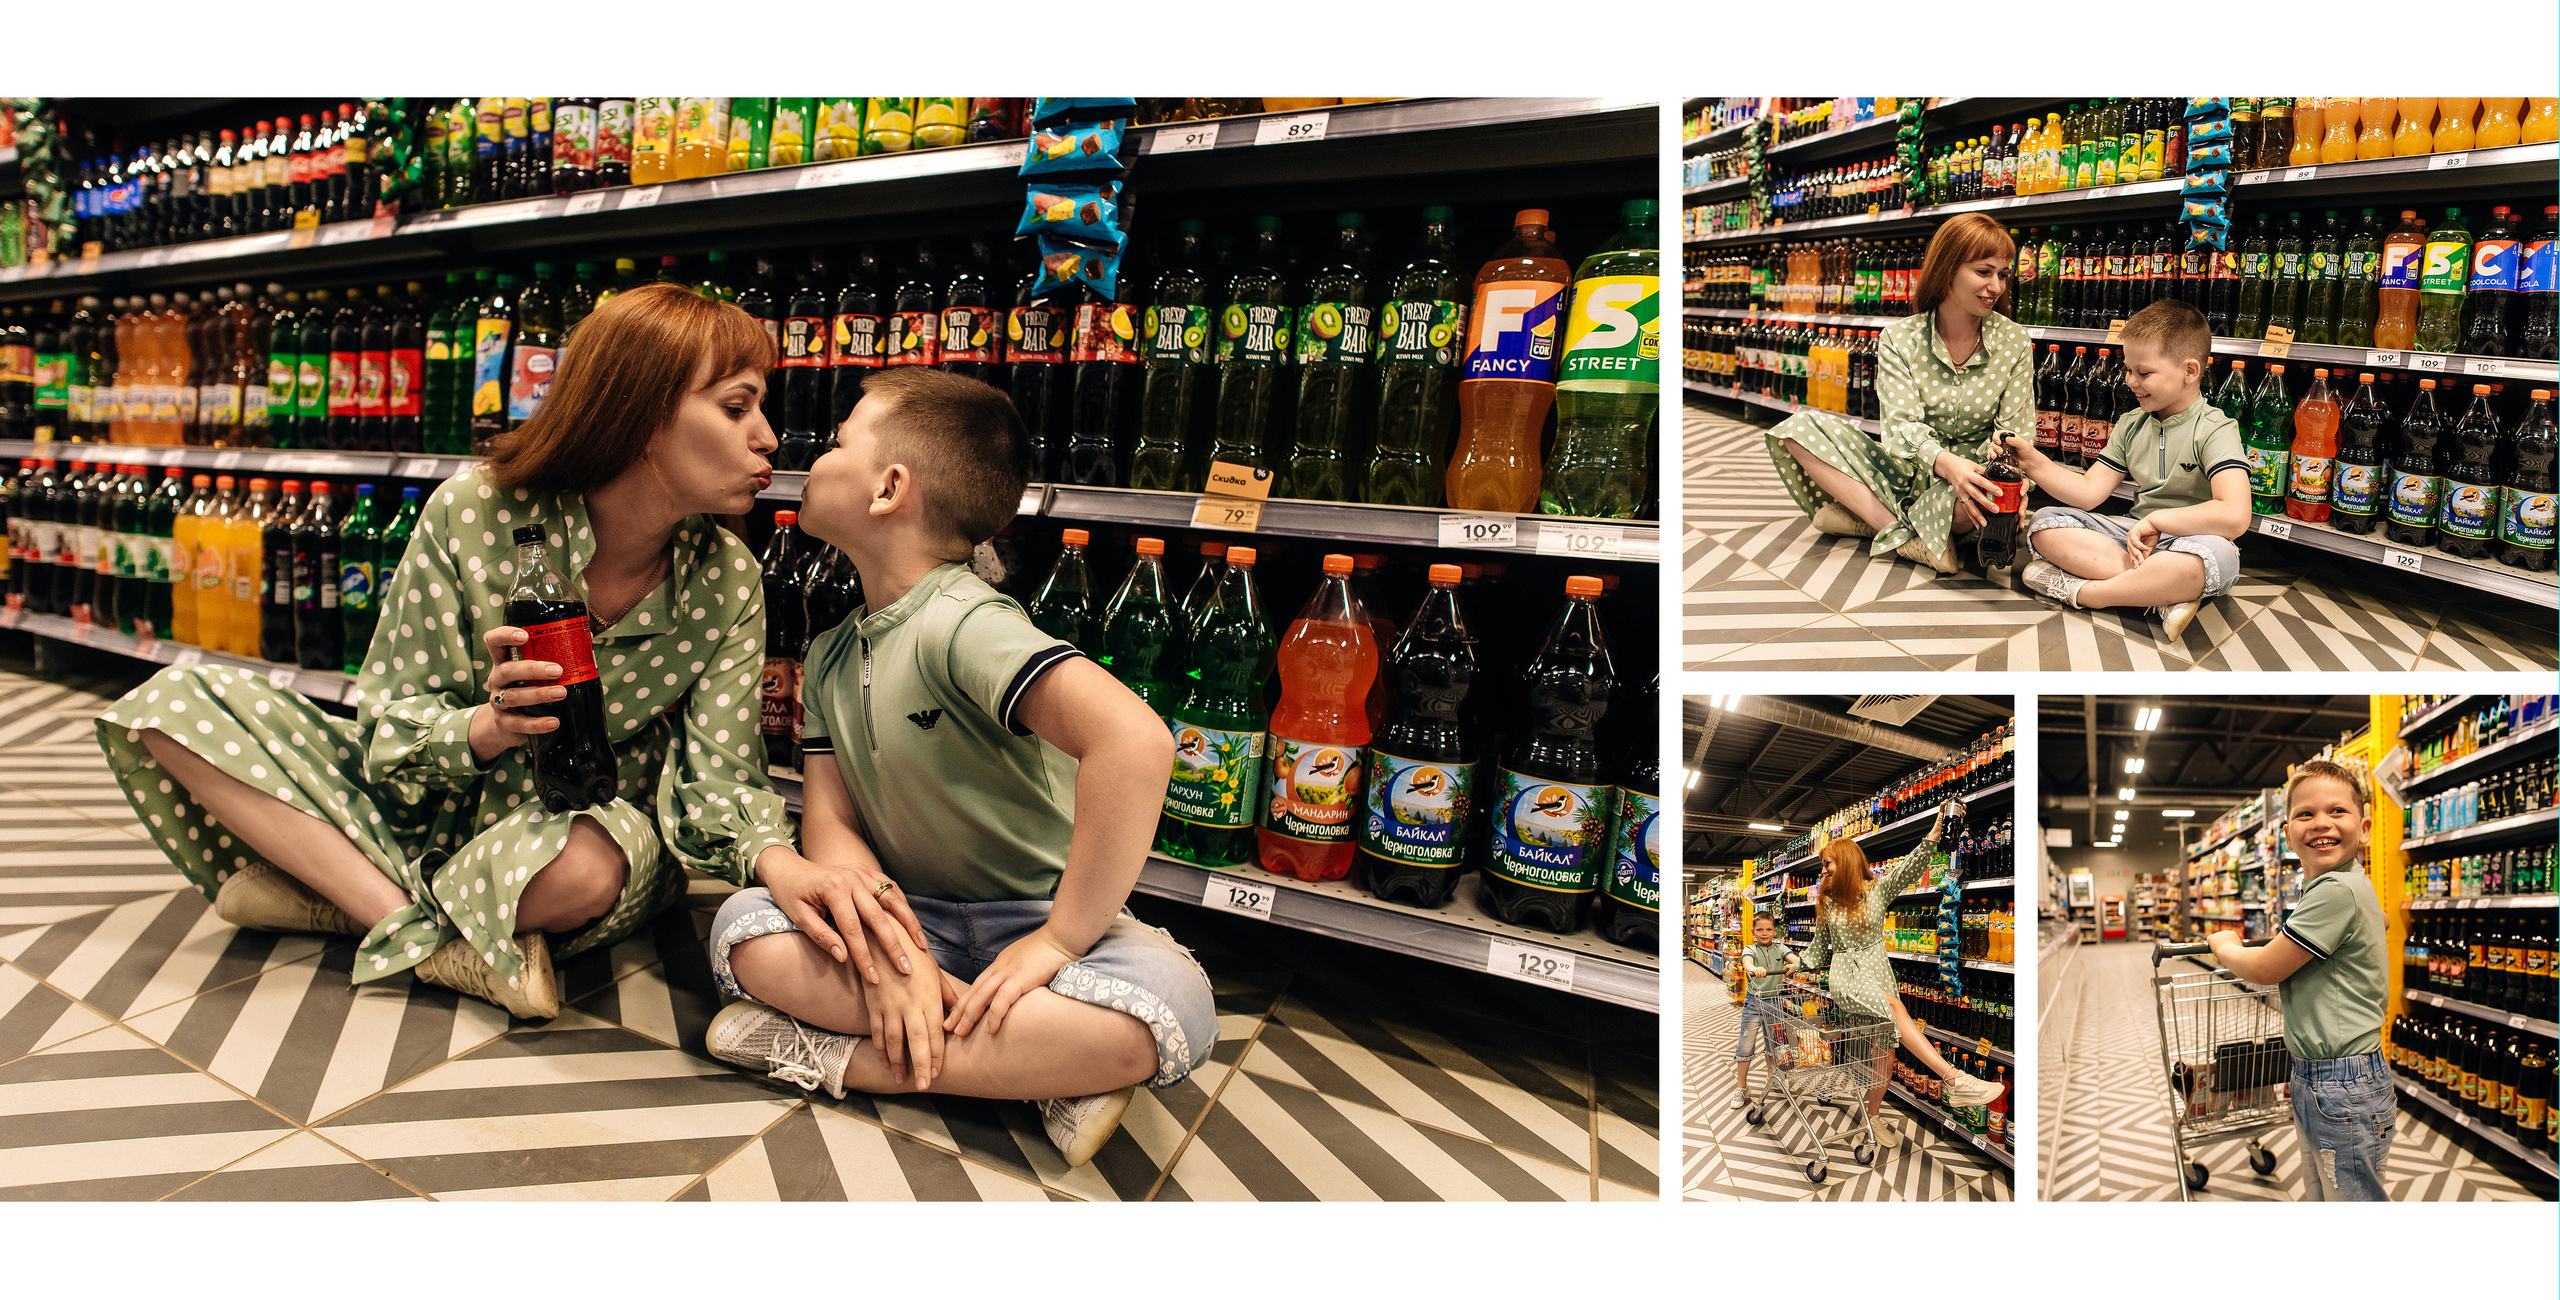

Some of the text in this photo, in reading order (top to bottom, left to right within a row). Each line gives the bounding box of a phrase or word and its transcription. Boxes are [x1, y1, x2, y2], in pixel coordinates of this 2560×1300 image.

[641, 97, 660, 110] ES!
[1288, 123, 1313, 137] 89
[1185, 133, 1204, 145] 91
[2245, 261, 2257, 274] BAR
[2349, 261, 2363, 274] BAR
[2385, 247, 2408, 276] F
[2424, 245, 2452, 276] S
[2475, 244, 2504, 276] C
[2283, 262, 2297, 275] BAR
[2325, 262, 2338, 276] BAR
[2470, 278, 2507, 286] COOLCOLA
[950, 310, 971, 326] FRESH
[1025, 310, 1049, 326] FRESH
[1160, 306, 1187, 324] FRESH
[1249, 306, 1278, 325] FRESH
[1345, 306, 1371, 326] FRESH
[1401, 302, 1433, 321] FRESH
[1570, 283, 1643, 351] S
[852, 318, 876, 333] FRESH
[1479, 289, 1537, 353] F
[947, 327, 969, 350] BAR
[1022, 326, 1048, 351] BAR
[1156, 324, 1183, 350] BAR
[1245, 324, 1274, 352] BAR
[1340, 324, 1367, 353] BAR
[1396, 321, 1428, 350] BAR
[850, 333, 873, 356] BAR
[1472, 359, 1531, 372] FANCY
[1568, 357, 1640, 371] STREET
[2377, 354, 2394, 362] 109
[2420, 359, 2439, 368] 109
[2477, 363, 2497, 372] 109
[1212, 474, 1246, 486] Скидка
[2343, 495, 2365, 504] БАЙКАЛ
[1225, 509, 1244, 521] 79
[2398, 505, 2421, 514] БАЙКАЛ
[2270, 524, 2285, 533] 129
[2455, 517, 2480, 526] БАЙКАЛ
[1463, 523, 1501, 538] 109
[2524, 528, 2550, 536] БАЙКАЛ
[1565, 534, 1605, 550] 109
[2397, 555, 2414, 566] 129
[1170, 783, 1203, 800] ТАРХУН
[1165, 796, 1214, 818] ерноголовка
[1292, 803, 1348, 819] МАНДАРИН
[1396, 826, 1443, 841] БАЙКАЛ
[1382, 834, 1453, 858] Черноголовка
[1519, 846, 1571, 865] БАЙКАЛ
[1503, 854, 1582, 883] Черноголовка
[1229, 888, 1260, 907] 129
[1518, 953, 1557, 975] 129
